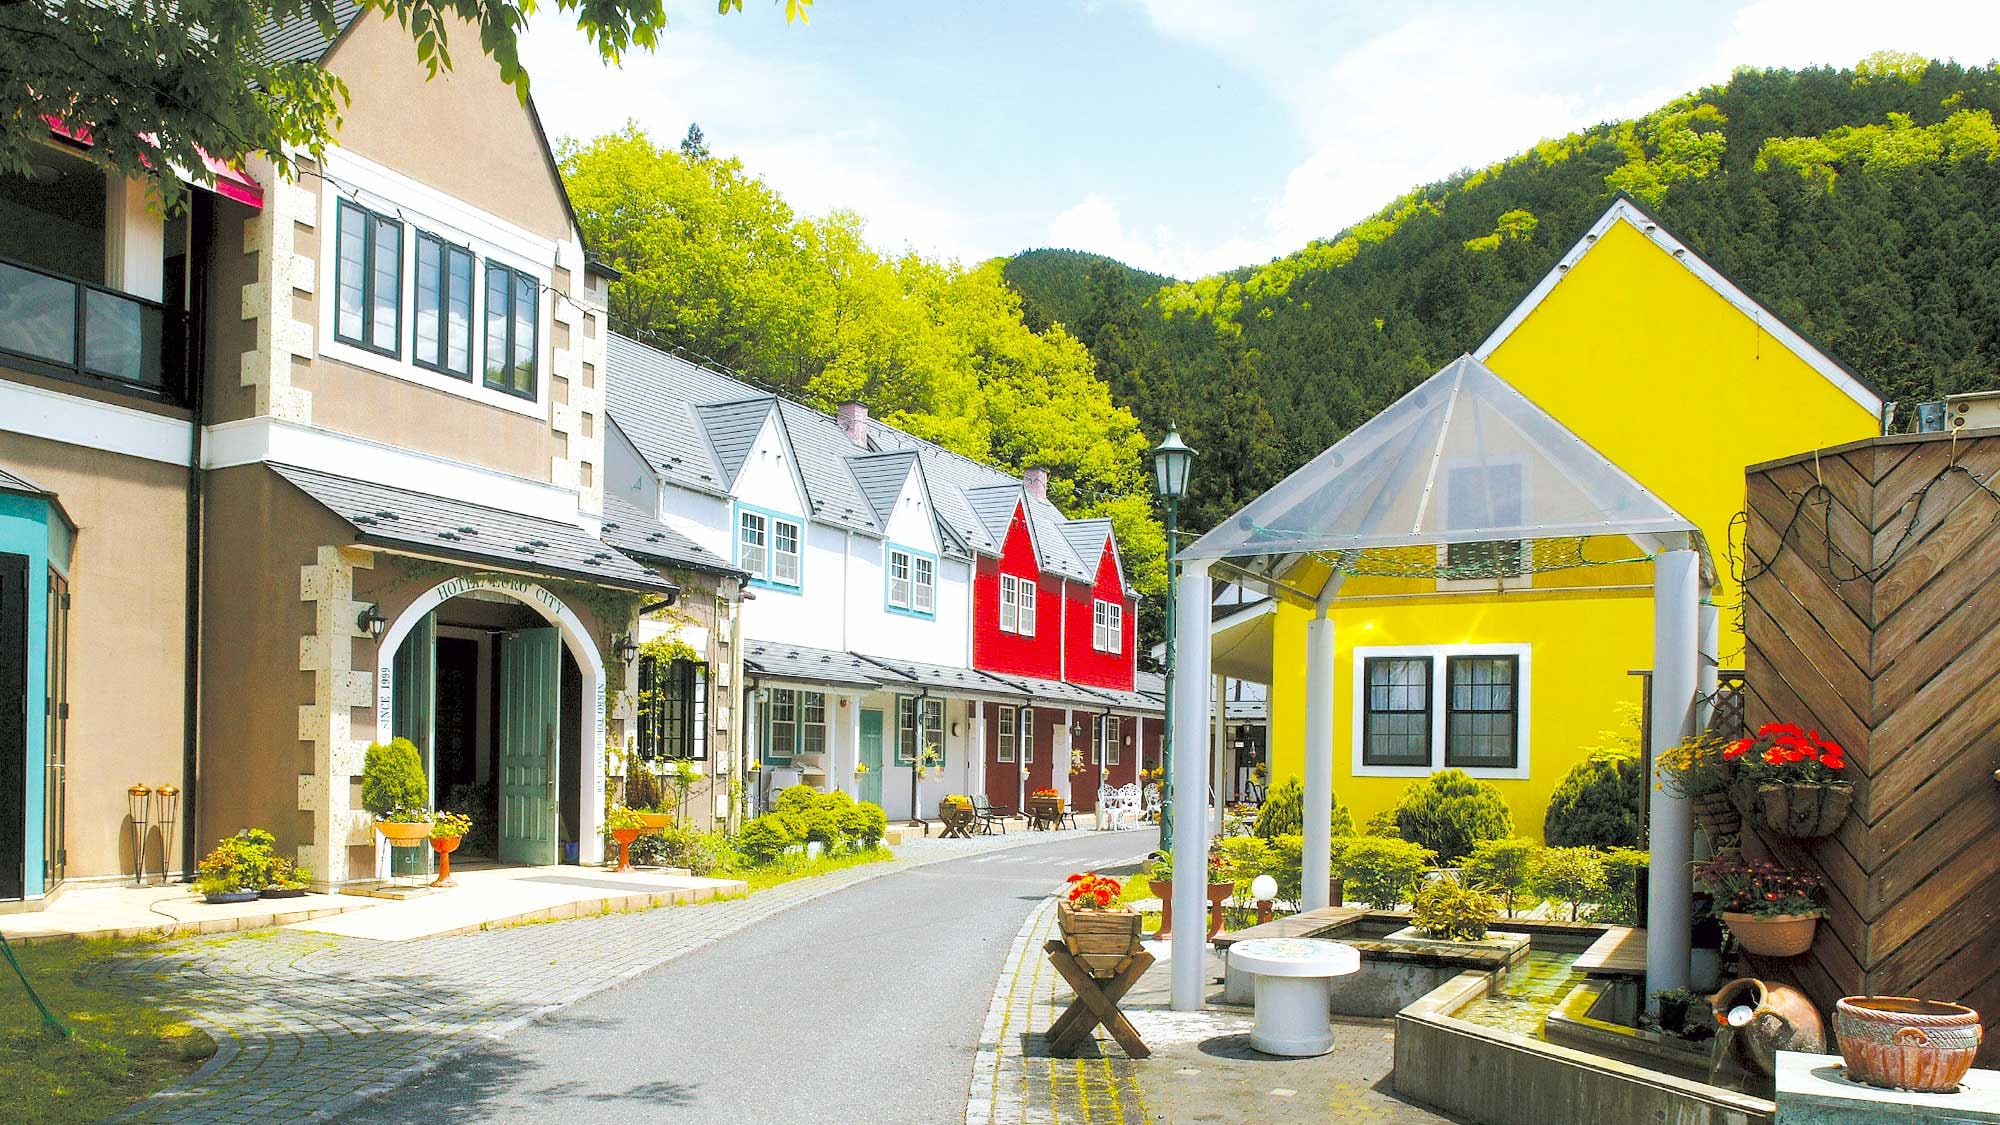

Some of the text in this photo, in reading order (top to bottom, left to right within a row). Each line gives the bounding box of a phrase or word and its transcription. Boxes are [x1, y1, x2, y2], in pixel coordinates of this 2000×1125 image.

[536, 588, 565, 614] CITY
[380, 667, 391, 729] SINCE 1999
[597, 683, 605, 715] NIKKO
